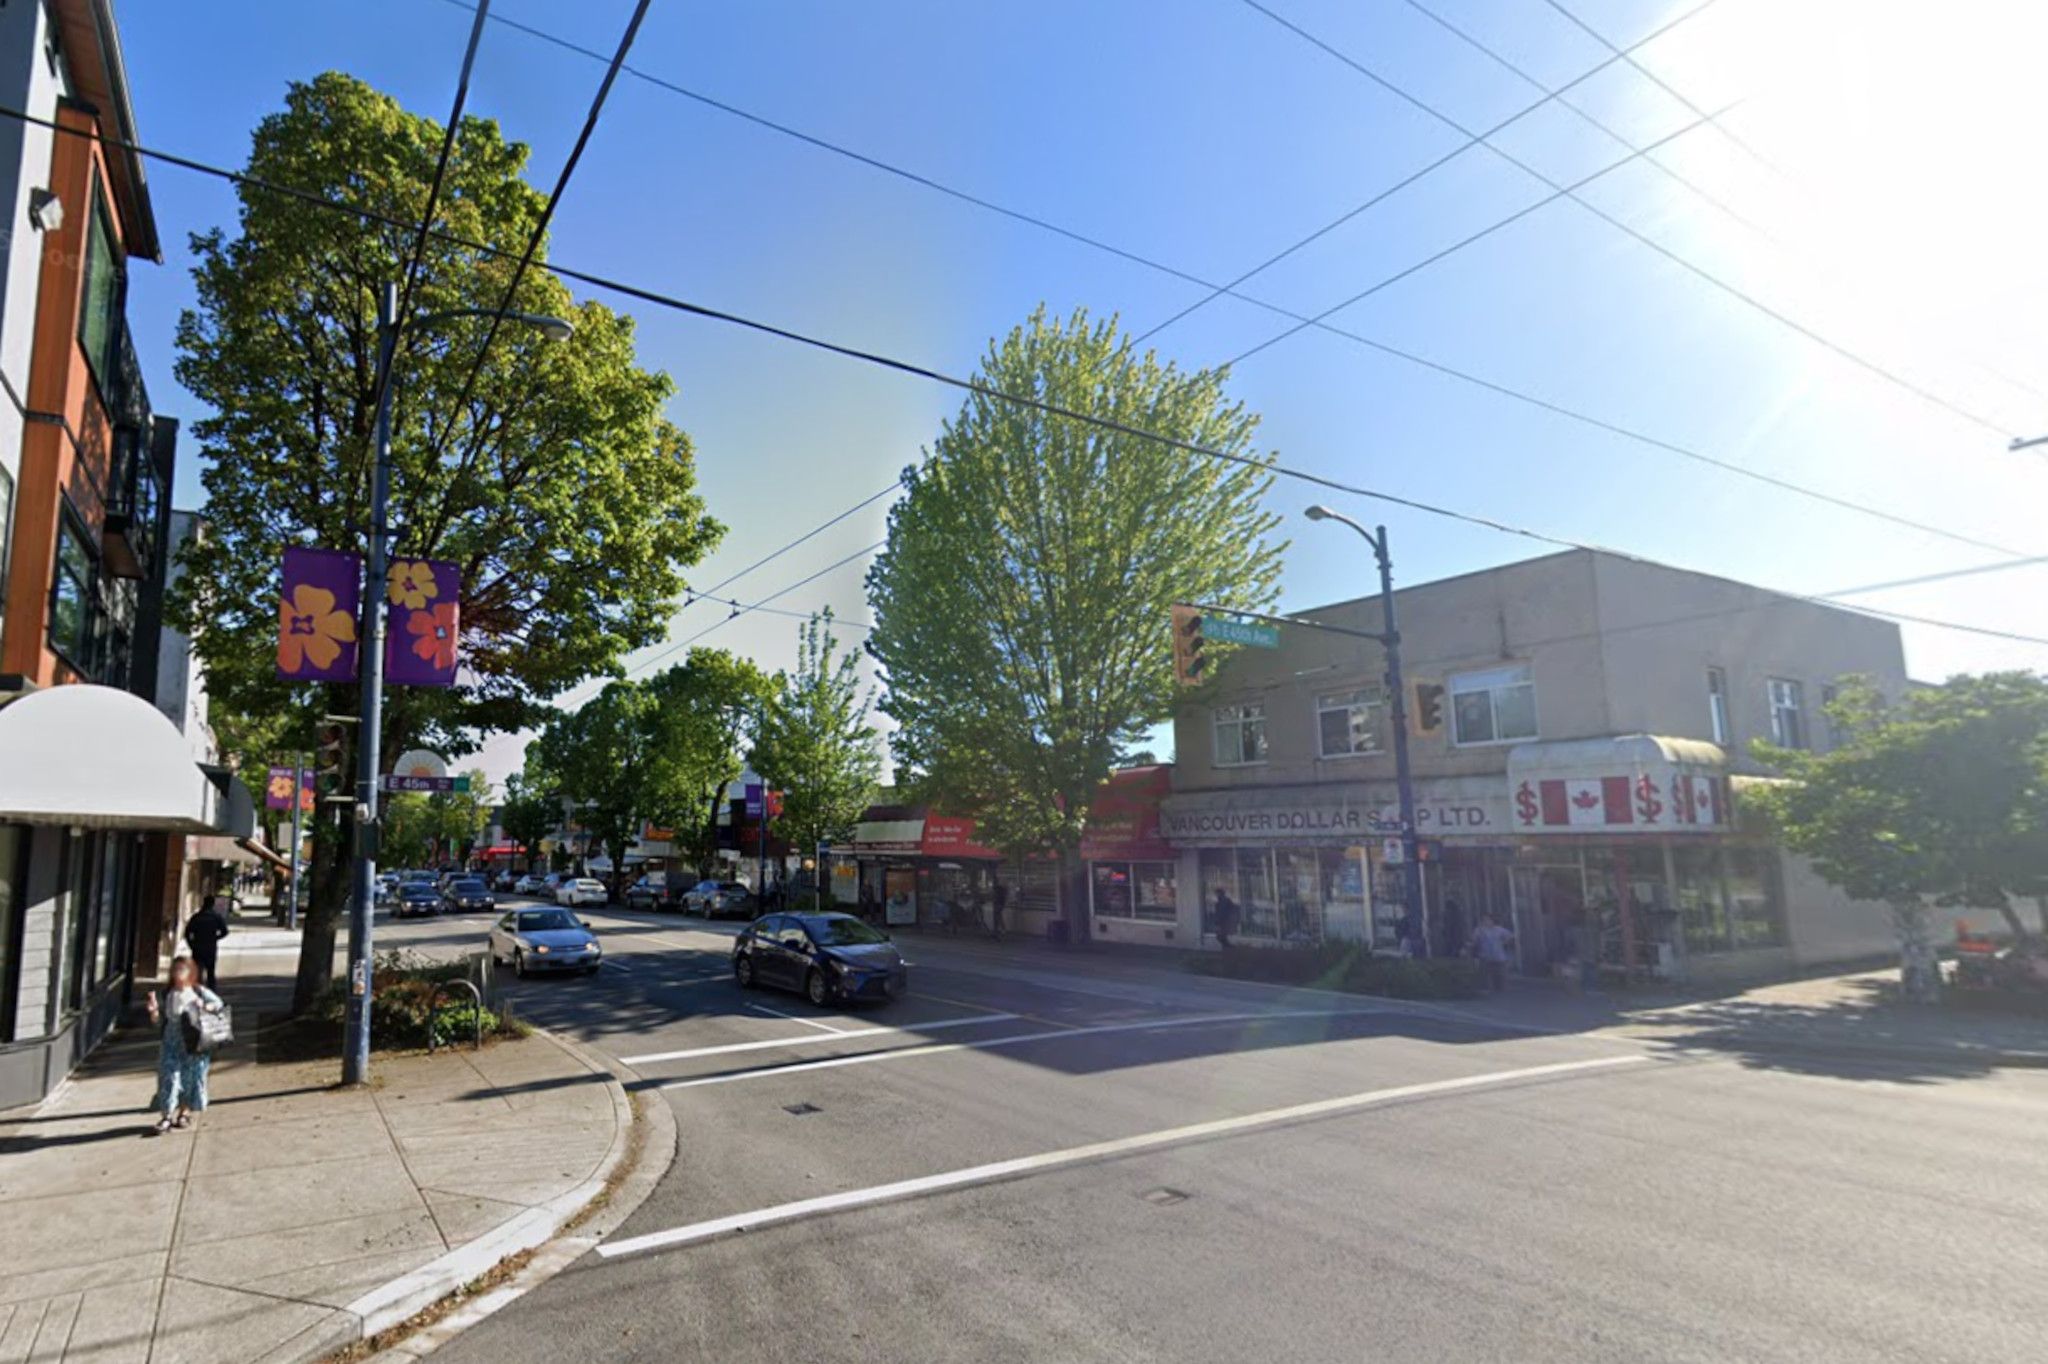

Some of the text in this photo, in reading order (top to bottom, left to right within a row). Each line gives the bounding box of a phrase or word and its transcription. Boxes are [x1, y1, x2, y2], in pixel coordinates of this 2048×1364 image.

[389, 777, 399, 788] E
[403, 777, 430, 788] 45th
[1168, 806, 1490, 831] VANCOUVER DOLLAR SP LTD.
